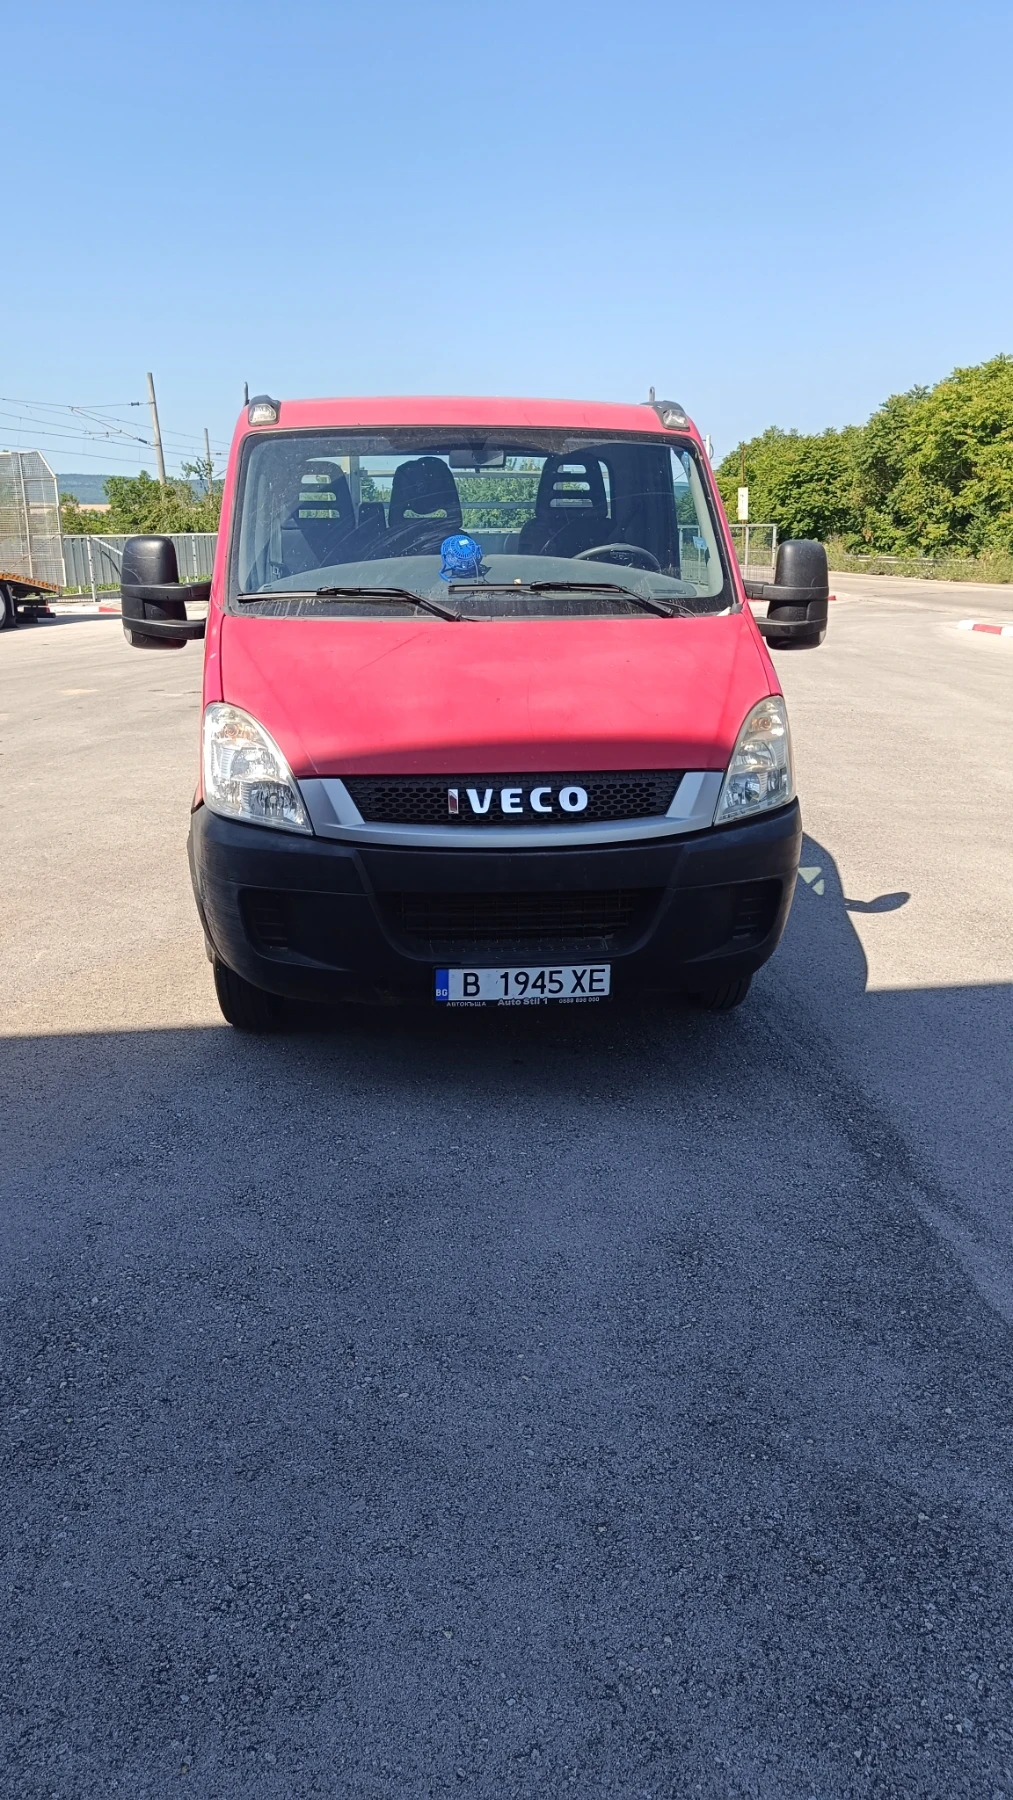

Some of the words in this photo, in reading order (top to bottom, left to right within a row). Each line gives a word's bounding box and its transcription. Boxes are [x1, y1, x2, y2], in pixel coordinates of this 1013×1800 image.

[448, 786, 588, 814] IVECO
[463, 972, 480, 997] B
[500, 970, 564, 996] 1945
[570, 968, 606, 993] XE
[435, 989, 448, 997] BG
[497, 998, 522, 1006] Auto
